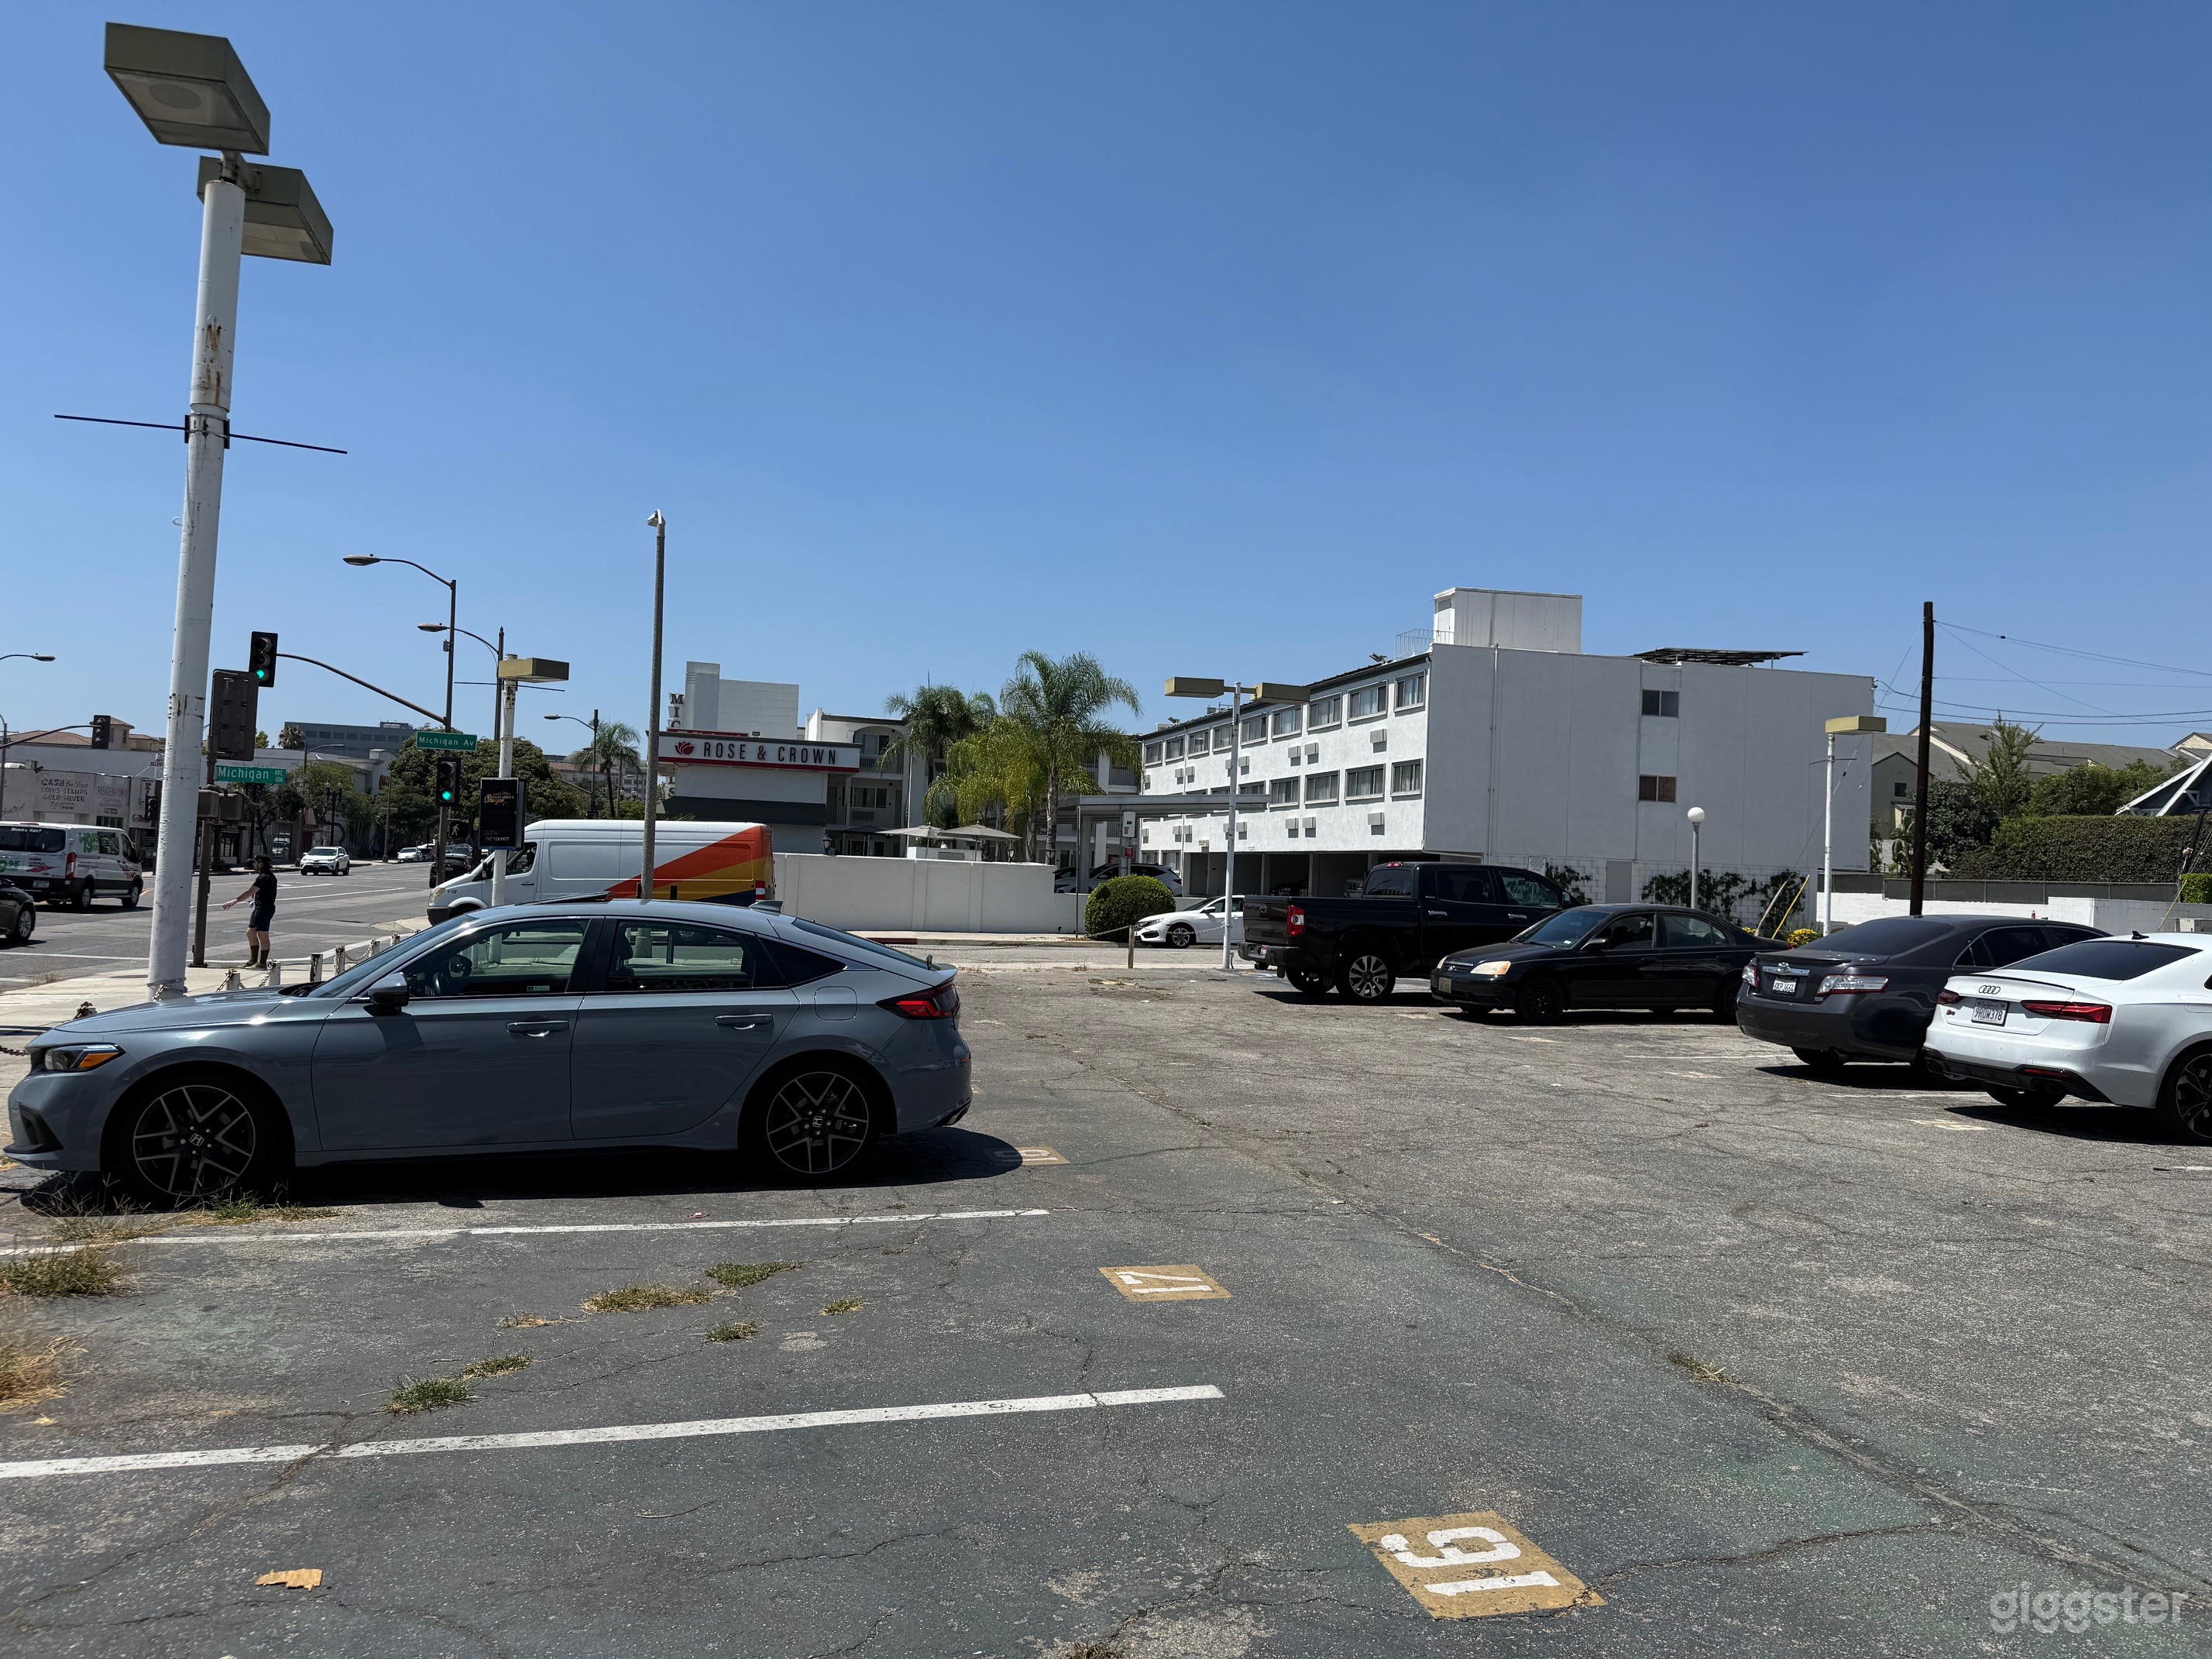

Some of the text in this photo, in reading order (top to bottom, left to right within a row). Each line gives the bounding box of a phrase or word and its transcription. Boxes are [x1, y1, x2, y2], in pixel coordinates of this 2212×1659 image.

[419, 736, 459, 747] Michigan
[703, 741, 836, 765] ROSE & CROWN
[41, 778, 64, 787] CASH
[218, 766, 269, 781] Michigan
[1115, 1271, 1214, 1293] 17
[1381, 1526, 1561, 1596] 16
